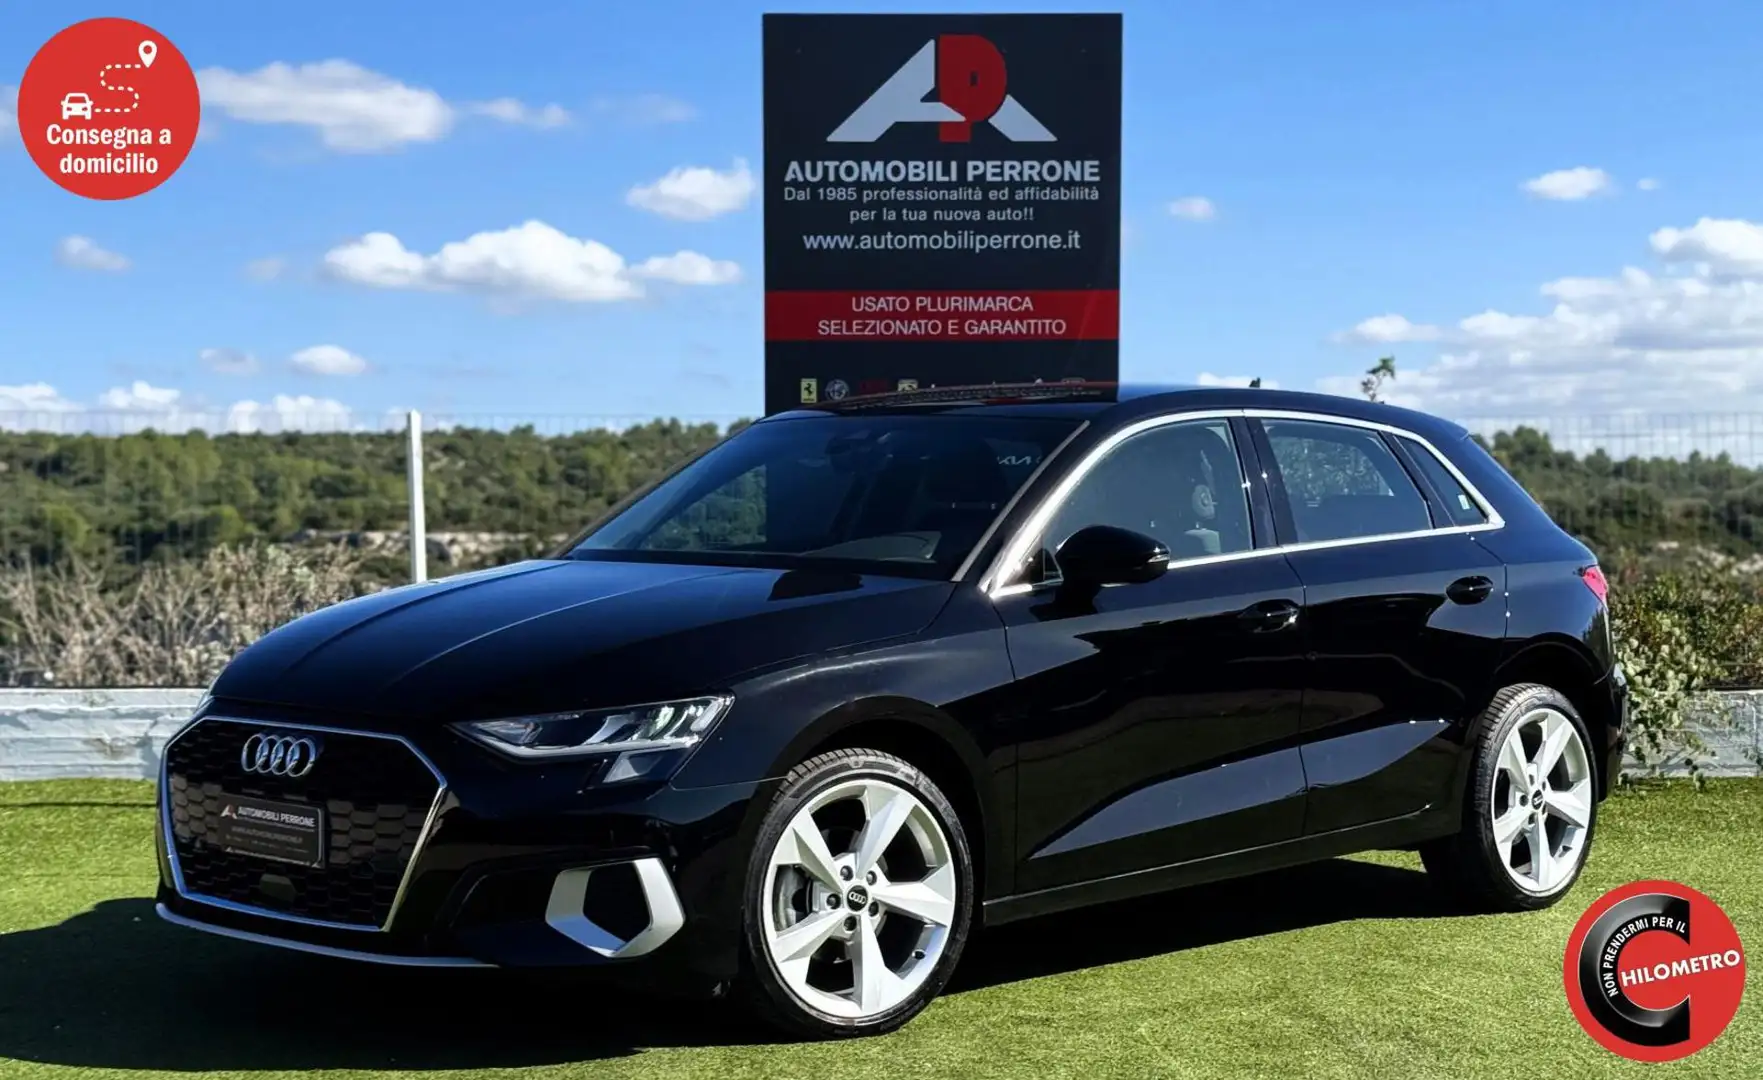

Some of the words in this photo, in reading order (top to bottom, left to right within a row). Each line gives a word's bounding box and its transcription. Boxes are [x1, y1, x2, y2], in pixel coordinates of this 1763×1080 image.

[784, 160, 958, 183] AUTOMOBILI
[966, 160, 1101, 183] PERRONE
[784, 186, 811, 201] Dal
[817, 187, 858, 201] 1985
[863, 186, 983, 204] professionalità
[988, 186, 1009, 201] ed
[1014, 186, 1099, 201] affidabilità
[850, 209, 876, 224] per
[883, 207, 897, 221] la
[902, 208, 928, 221] tua
[933, 209, 981, 221] nuova
[987, 207, 1034, 221] auto!!
[803, 229, 1081, 253] www.automobiliperrone.it
[852, 296, 910, 312] USATO
[916, 296, 1034, 312] PLURIMARCA
[818, 319, 942, 335] SELEZIONATO
[948, 319, 959, 335] E
[964, 319, 1067, 335] GARANTITO
[238, 806, 280, 821] AUTOMOBILI
[280, 813, 316, 828] PERRONE
